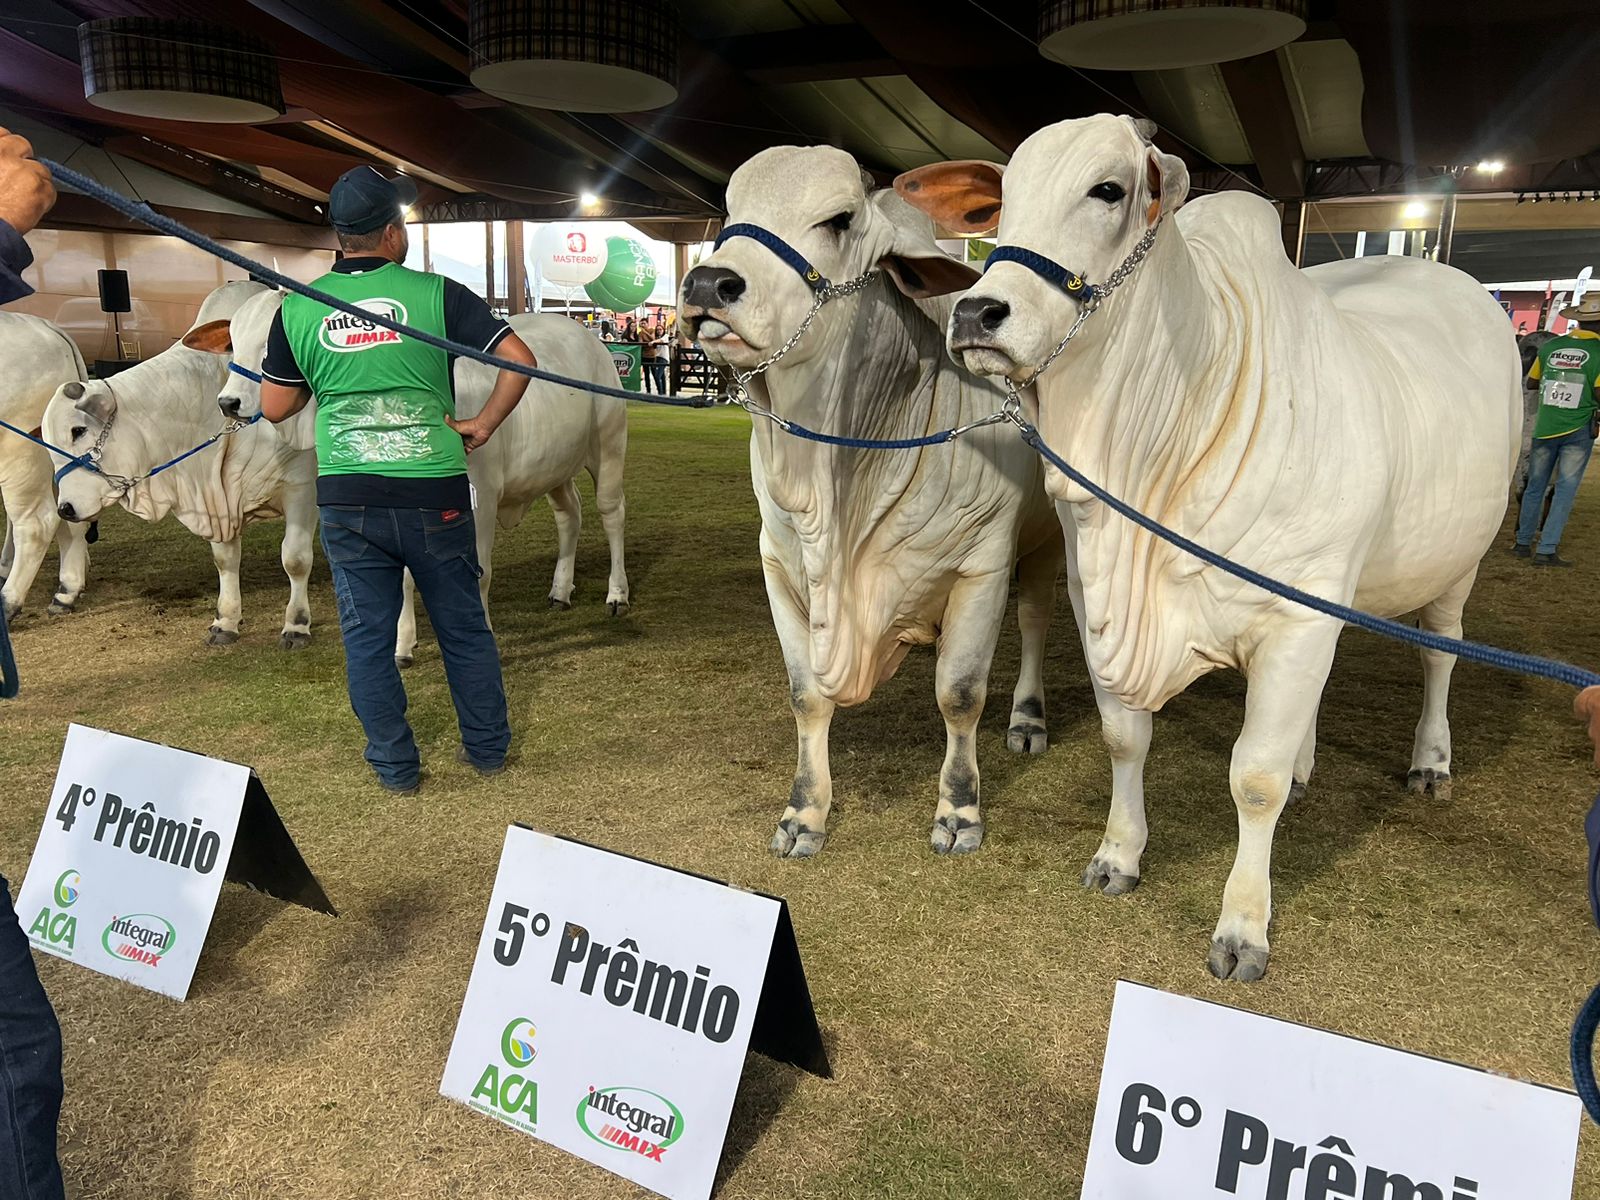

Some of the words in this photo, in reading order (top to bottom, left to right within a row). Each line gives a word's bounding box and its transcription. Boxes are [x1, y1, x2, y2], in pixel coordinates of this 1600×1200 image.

[324, 308, 397, 332] integl
[55, 783, 96, 832] 4°
[93, 792, 220, 874] Prêmio
[28, 906, 77, 949] ACA
[111, 915, 171, 949] integral
[492, 902, 551, 967] 5°
[550, 921, 741, 1044] Prêmio
[471, 1063, 538, 1124] ACA
[587, 1085, 676, 1140] integral
[1114, 1082, 1202, 1166] 6°
